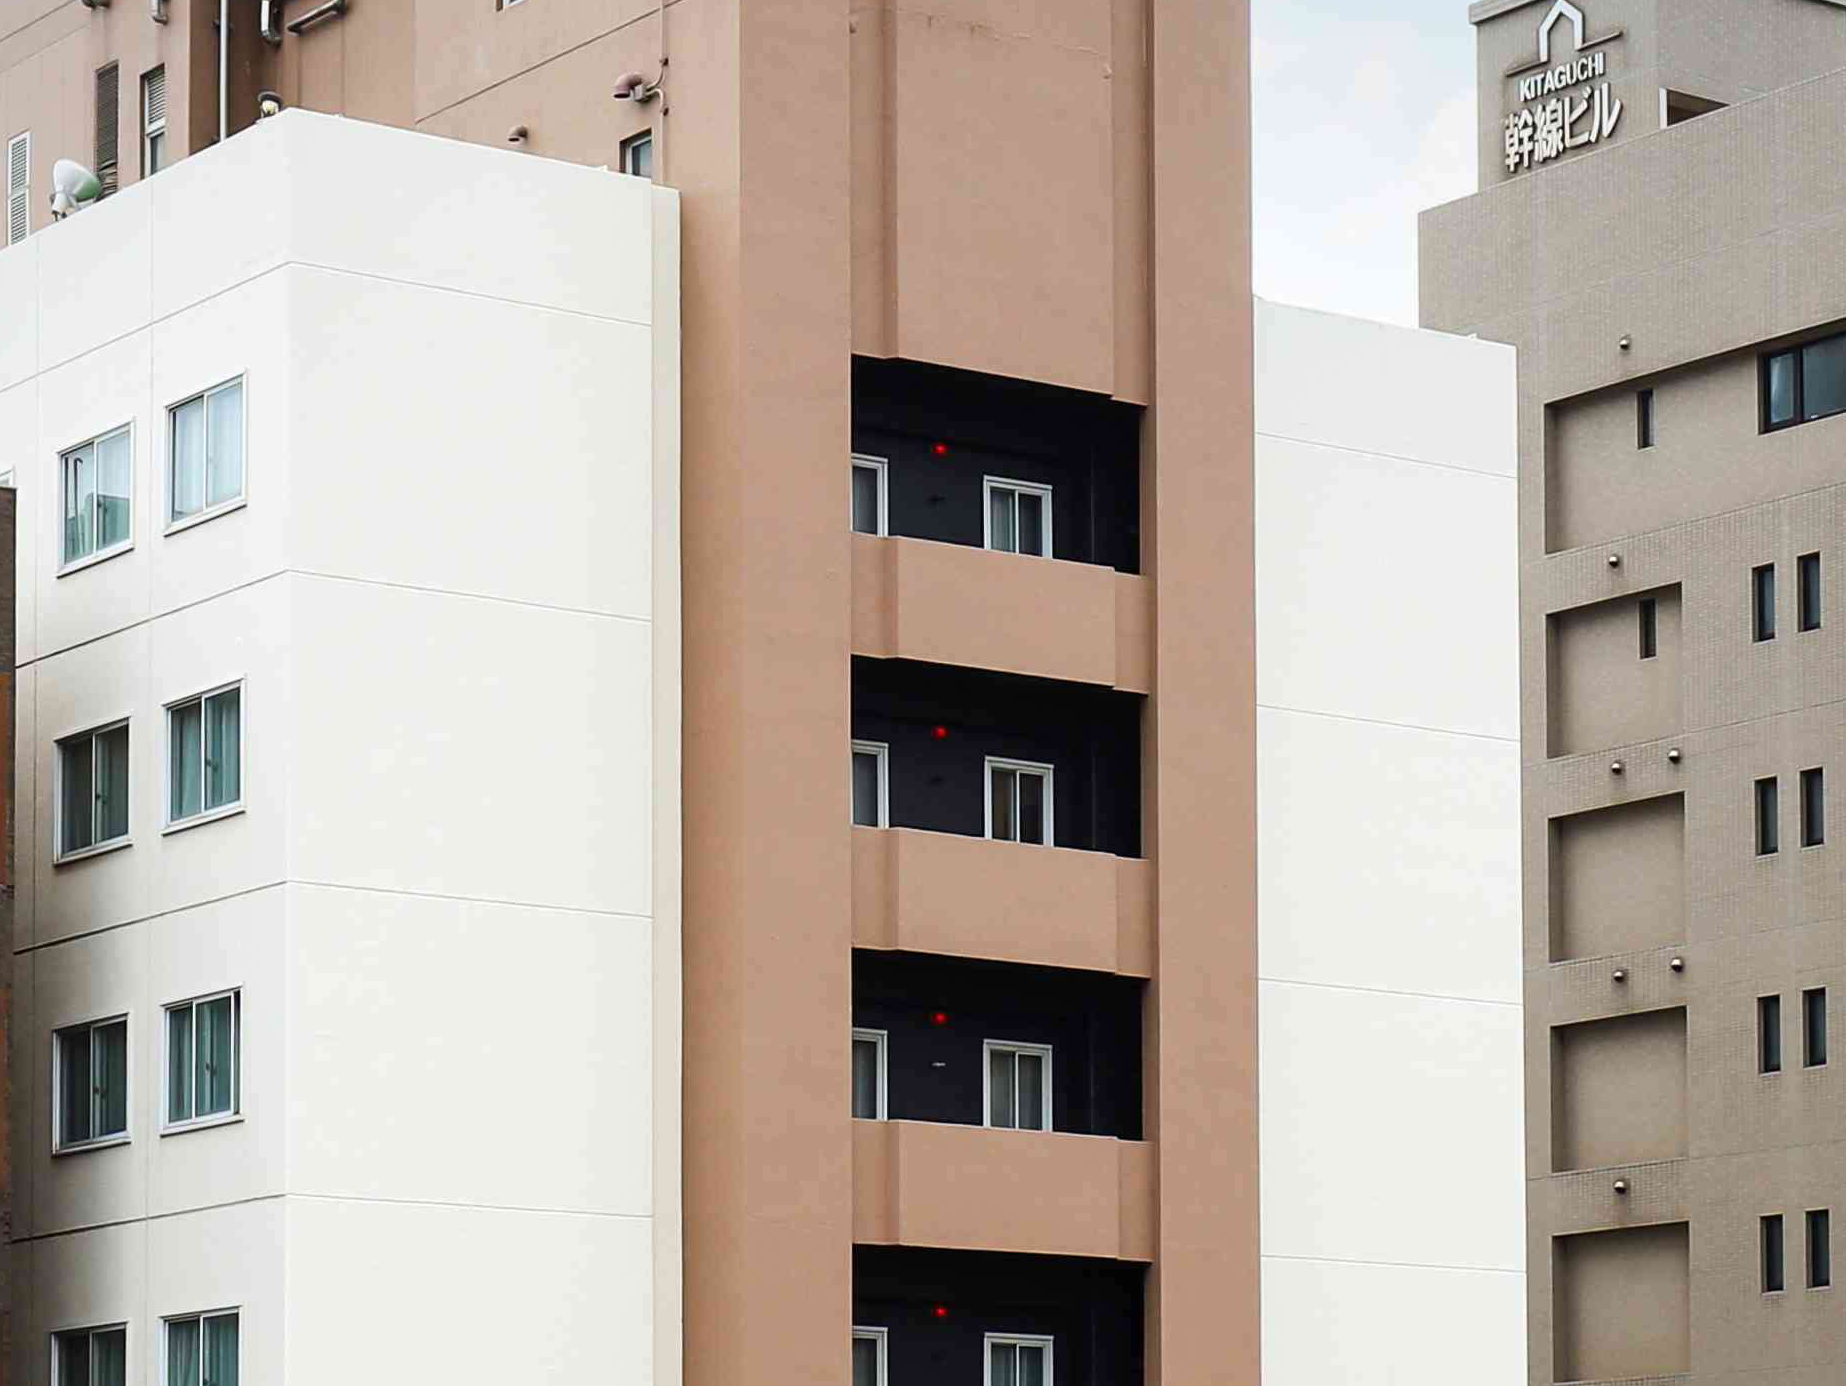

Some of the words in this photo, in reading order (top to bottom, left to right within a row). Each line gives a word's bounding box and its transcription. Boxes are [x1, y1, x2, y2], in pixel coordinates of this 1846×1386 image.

[1520, 52, 1605, 102] KITAGUCHI
[1505, 82, 1623, 173] 幹線ビル
